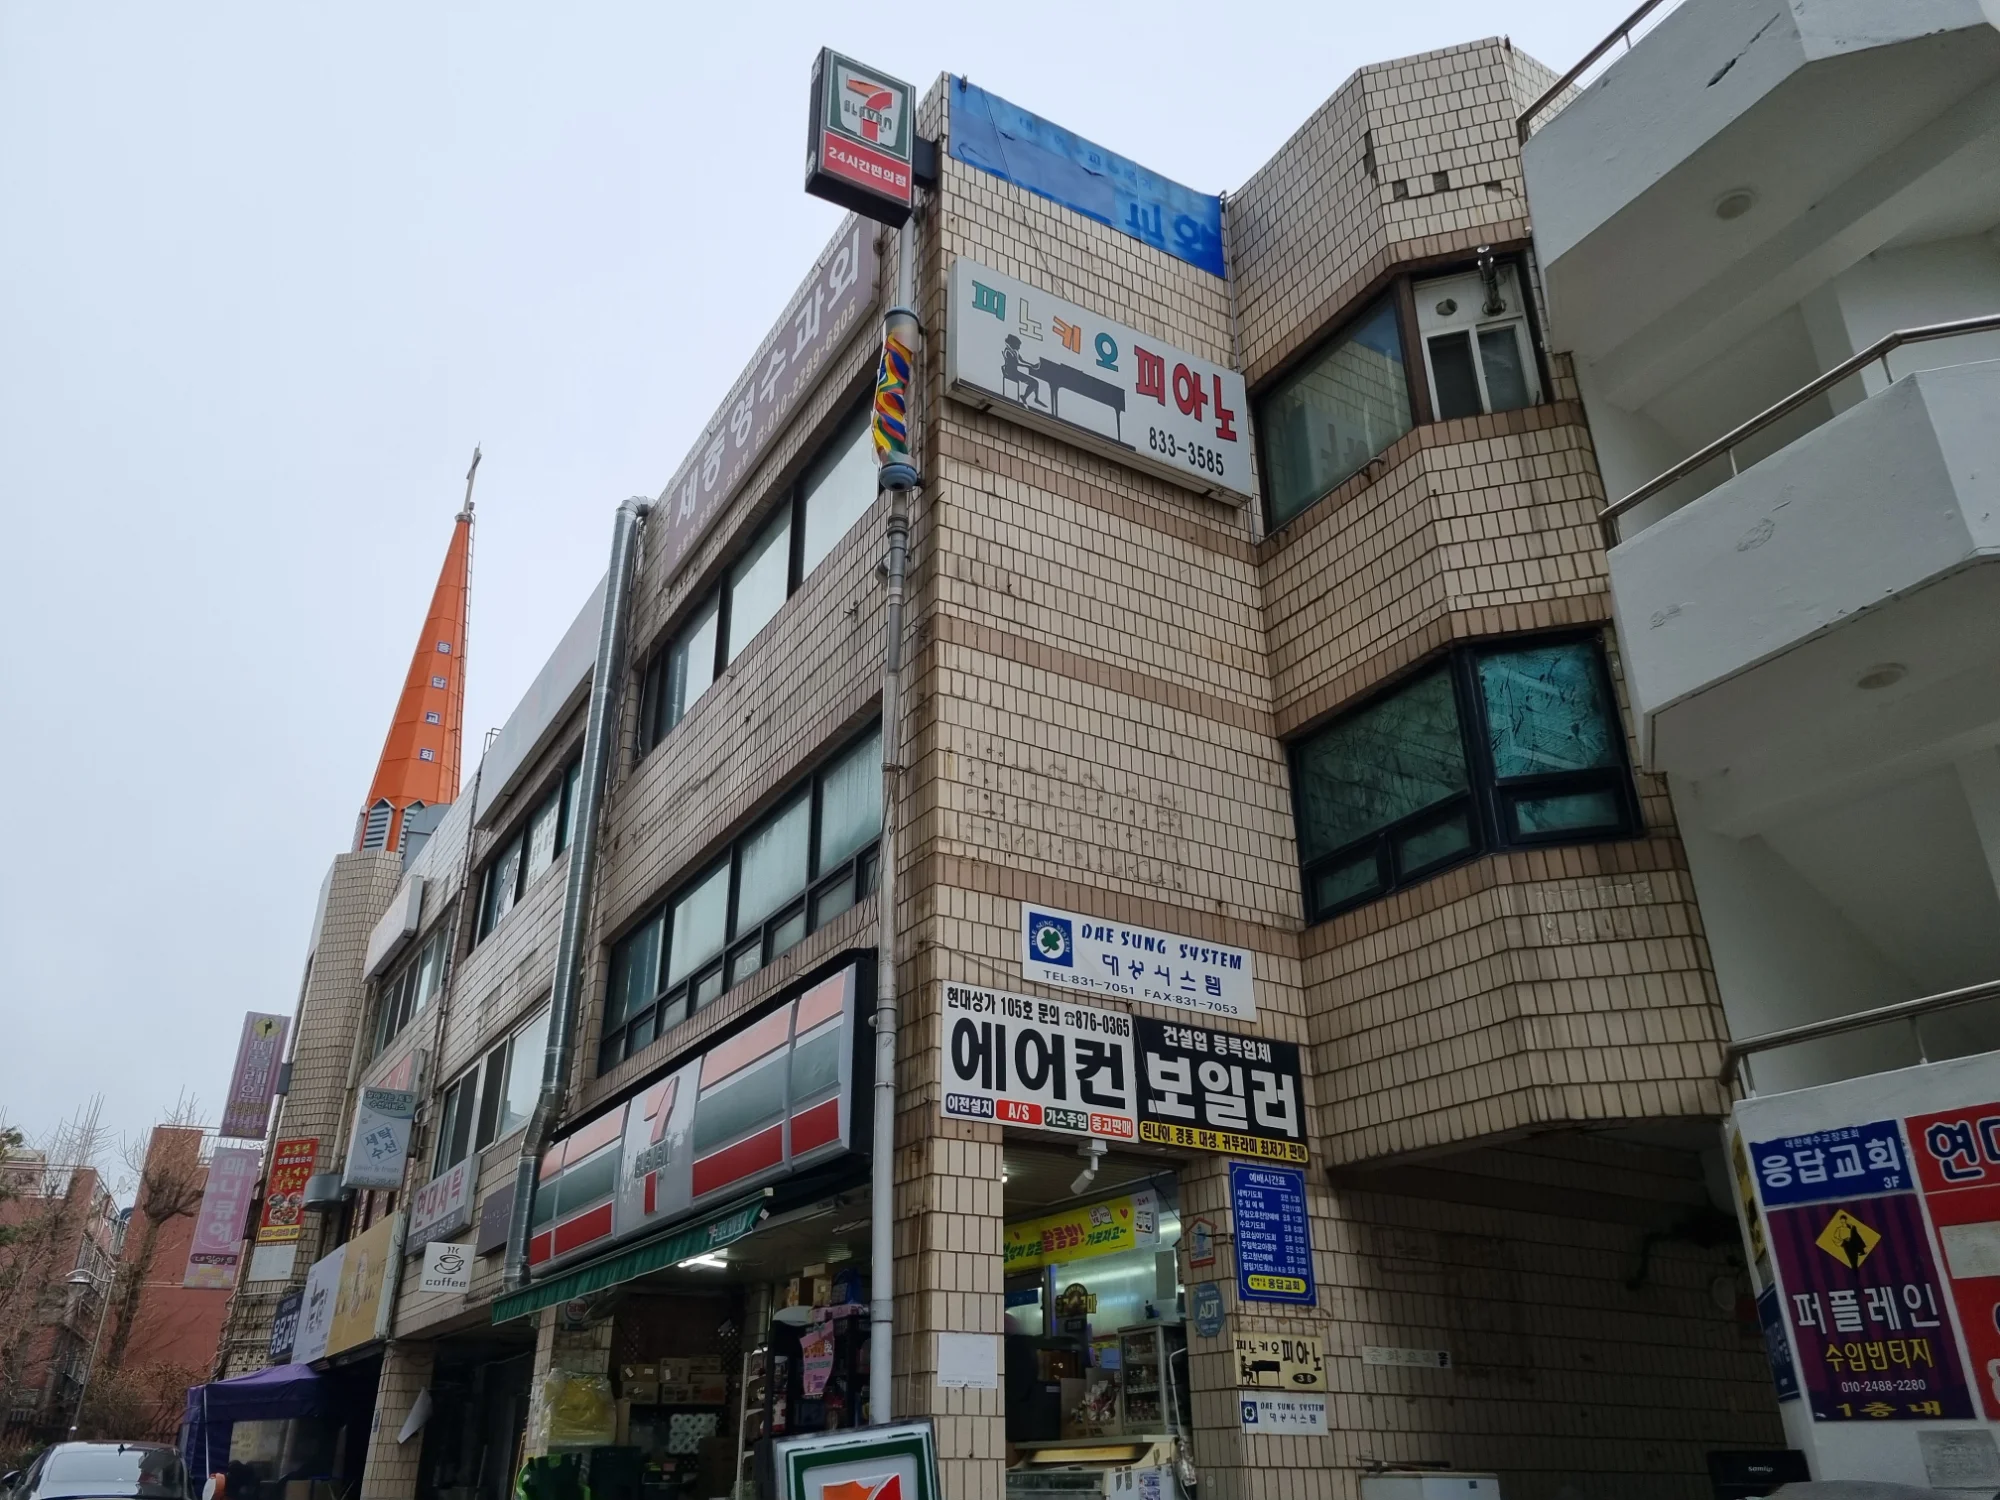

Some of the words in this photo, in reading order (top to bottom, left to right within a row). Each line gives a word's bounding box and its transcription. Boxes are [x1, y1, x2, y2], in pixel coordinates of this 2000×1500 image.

[846, 73, 893, 142] 7
[829, 147, 907, 187] 24시간편의점
[972, 280, 1119, 372] 피노키오
[1134, 345, 1237, 442] 피아노
[676, 227, 860, 528] 세종영수과외
[1149, 426, 1225, 476] 833-3585
[1082, 923, 1115, 944] DAE
[1121, 930, 1166, 954] SUNG
[1179, 943, 1242, 970] SYSTEM
[1043, 969, 1134, 995] TEL:831-7051
[1145, 988, 1238, 1015] FAX:831-7053
[947, 986, 996, 1015] 현대상가
[1000, 997, 1034, 1021] 105호
[1038, 1002, 1060, 1027] 문의
[1162, 1025, 1208, 1052] 건설업
[1213, 1034, 1272, 1063] 등록업체
[951, 1017, 1126, 1110] 에어컨
[947, 1095, 993, 1116] 이전설치
[1146, 1052, 1299, 1138] 보일러
[1008, 1103, 1030, 1121] A/S
[1046, 1109, 1088, 1130] 가스주입
[365, 1126, 392, 1146] 세탁
[1092, 1118, 1132, 1136] 중고판매
[1785, 1128, 1860, 1149] 대한예수교장로회
[371, 1140, 398, 1160] 수선
[1222, 1134, 1258, 1154] 귀뚜라미
[1260, 1139, 1287, 1158] 최저가
[1762, 1137, 1901, 1187] 응답교회
[1248, 1173, 1286, 1186] 예배시간표
[1883, 1176, 1900, 1189] 3F
[209, 1157, 247, 1241] 매니큐어
[1239, 1220, 1266, 1230] 수요기도회
[425, 1278, 467, 1287] coffee
[1268, 1278, 1300, 1291] 응답교회
[1198, 1299, 1219, 1320] ADT
[1793, 1283, 1941, 1335] 퍼플레인
[1236, 1339, 1281, 1355] 피노키오
[1281, 1339, 1323, 1372] 피아노
[1826, 1338, 1934, 1373] 수입빈티지
[1841, 1379, 1926, 1393] 010-2488-2280
[1260, 1401, 1274, 1411] DAE
[1277, 1402, 1296, 1411] SUNG
